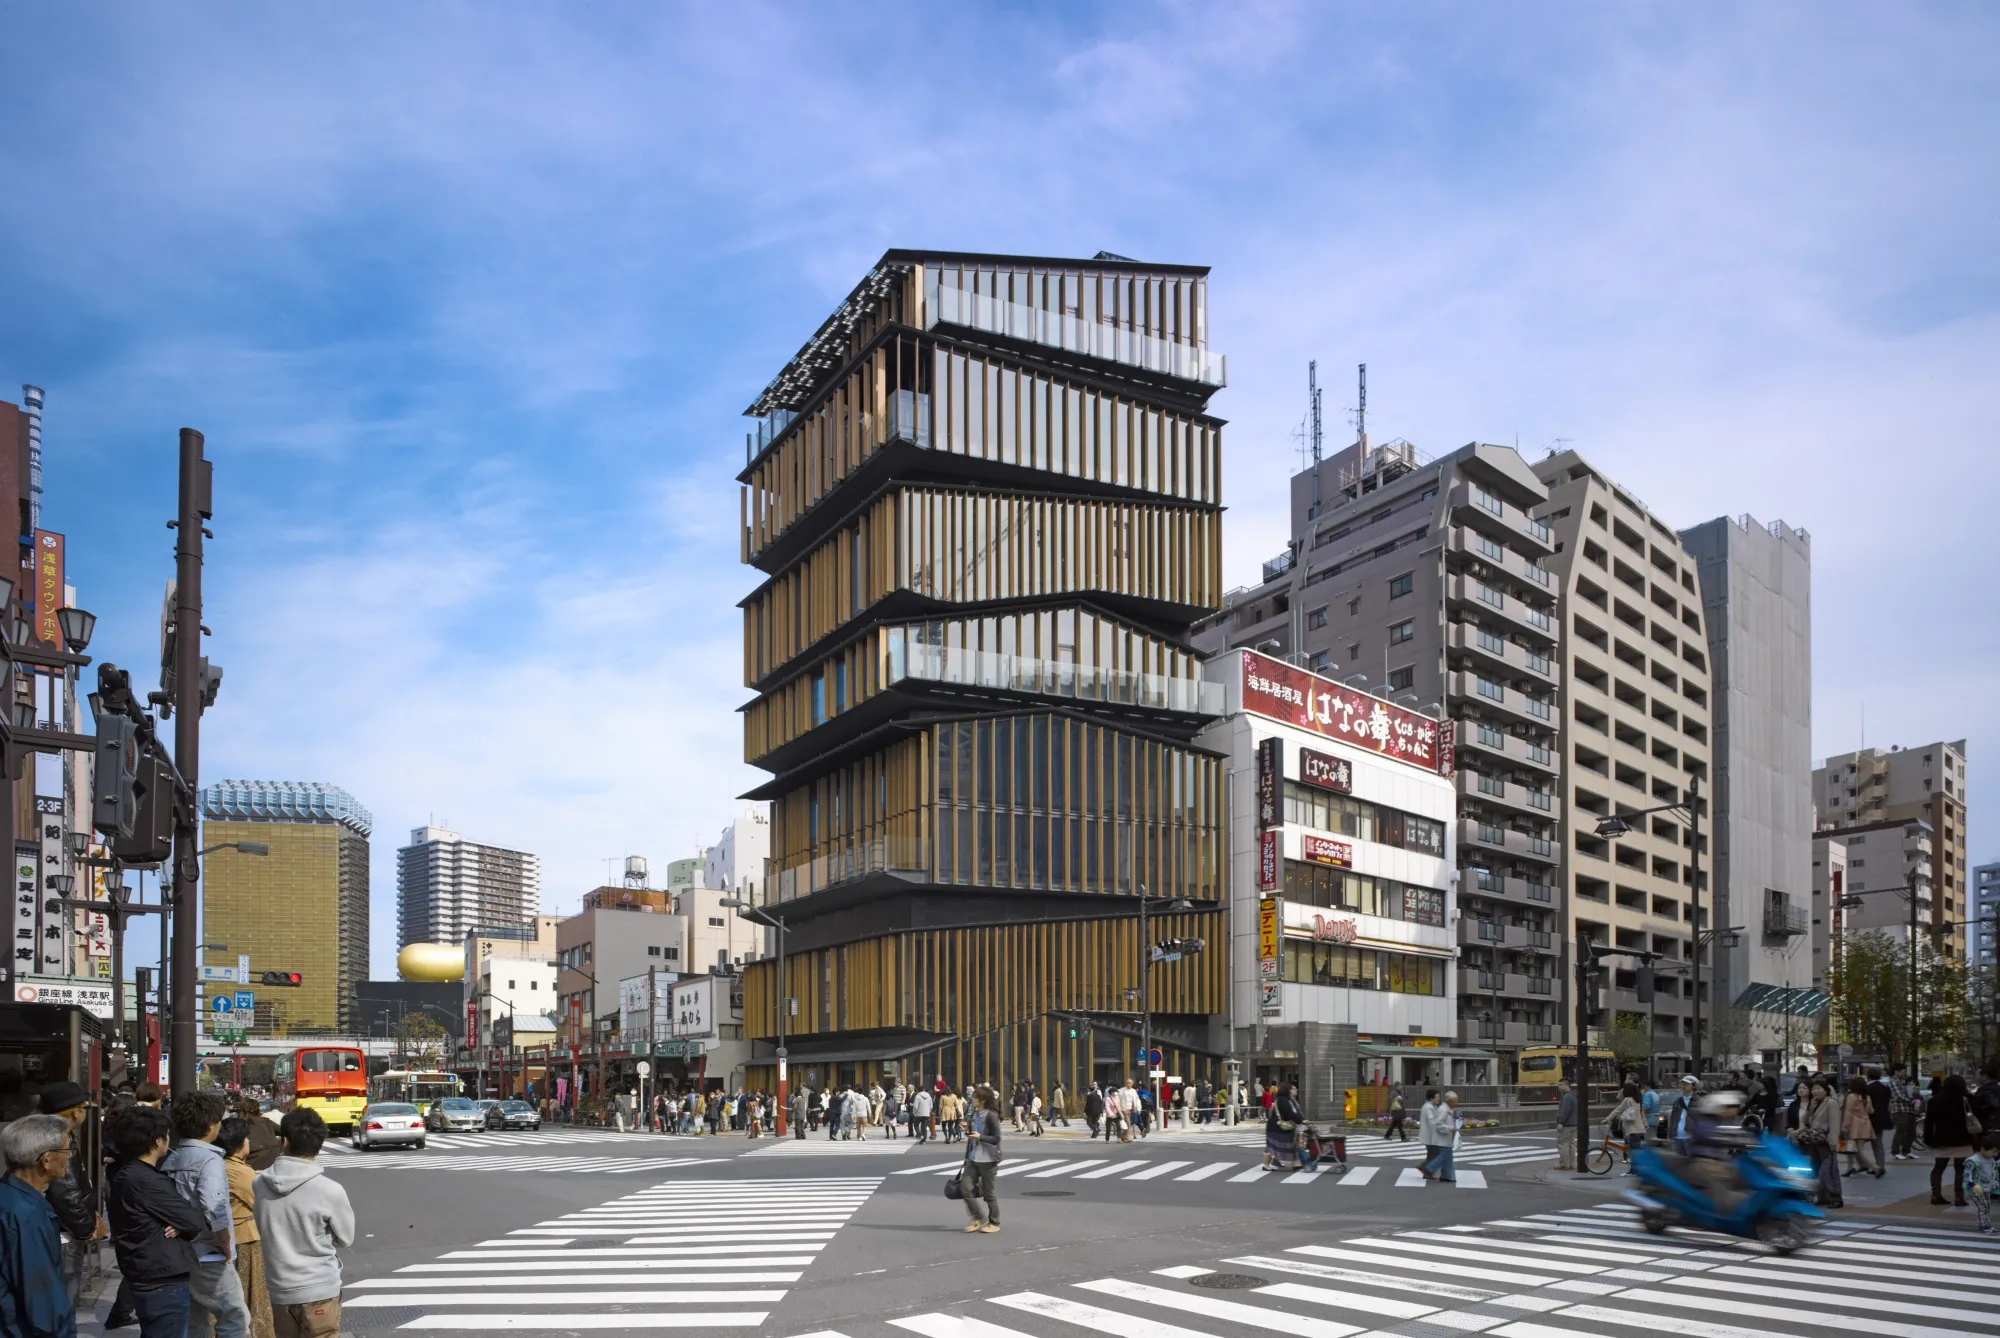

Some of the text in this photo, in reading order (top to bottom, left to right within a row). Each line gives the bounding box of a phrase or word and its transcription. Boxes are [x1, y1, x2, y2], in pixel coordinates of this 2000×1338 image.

[43, 552, 56, 641] 浅草タウンホテ
[1248, 675, 1303, 706] 海鮮居酒屋
[1307, 686, 1393, 750] はなの舞
[1305, 757, 1350, 788] はなの舞
[1262, 911, 1276, 957] デニーズ
[1312, 914, 1357, 943] Denny's
[1262, 963, 1275, 973] 2F
[38, 988, 110, 1000] 銀座線 浅草駅
